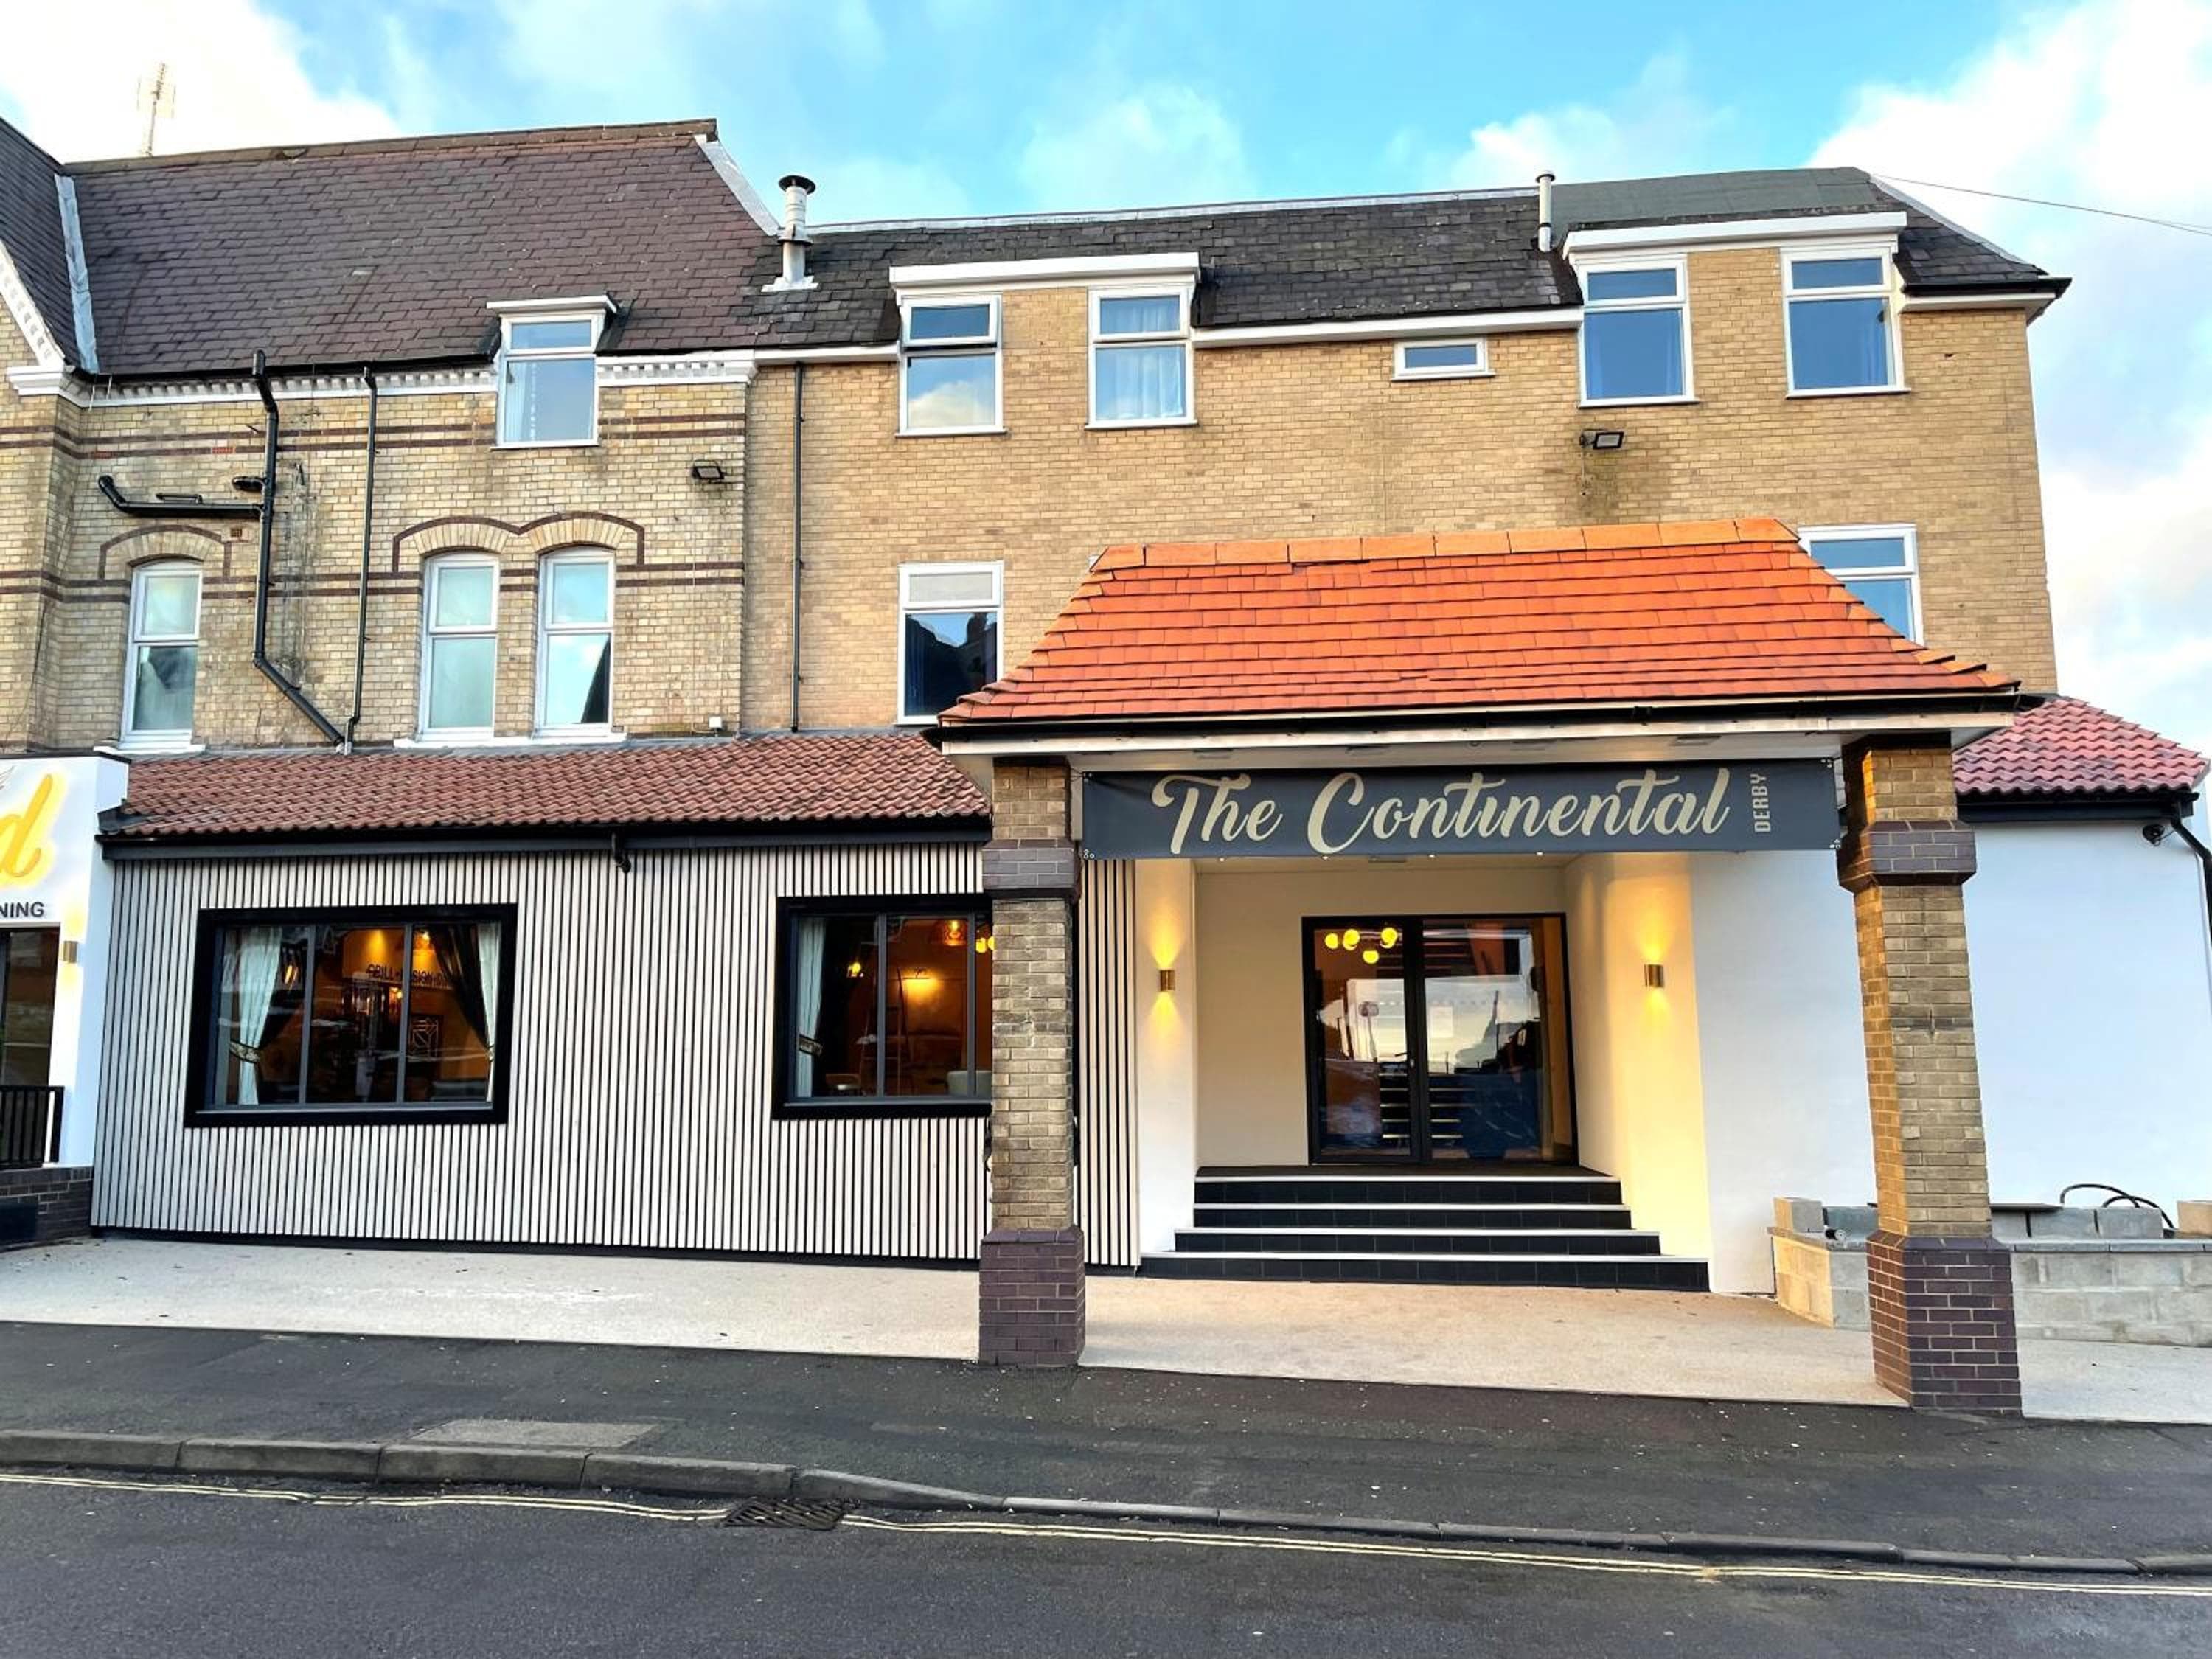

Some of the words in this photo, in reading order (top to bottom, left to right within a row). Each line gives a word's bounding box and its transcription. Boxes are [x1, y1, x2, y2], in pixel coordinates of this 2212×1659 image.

[1152, 773, 1283, 855] The
[1307, 768, 1730, 854] Continental
[1750, 773, 1770, 832] DERBY
